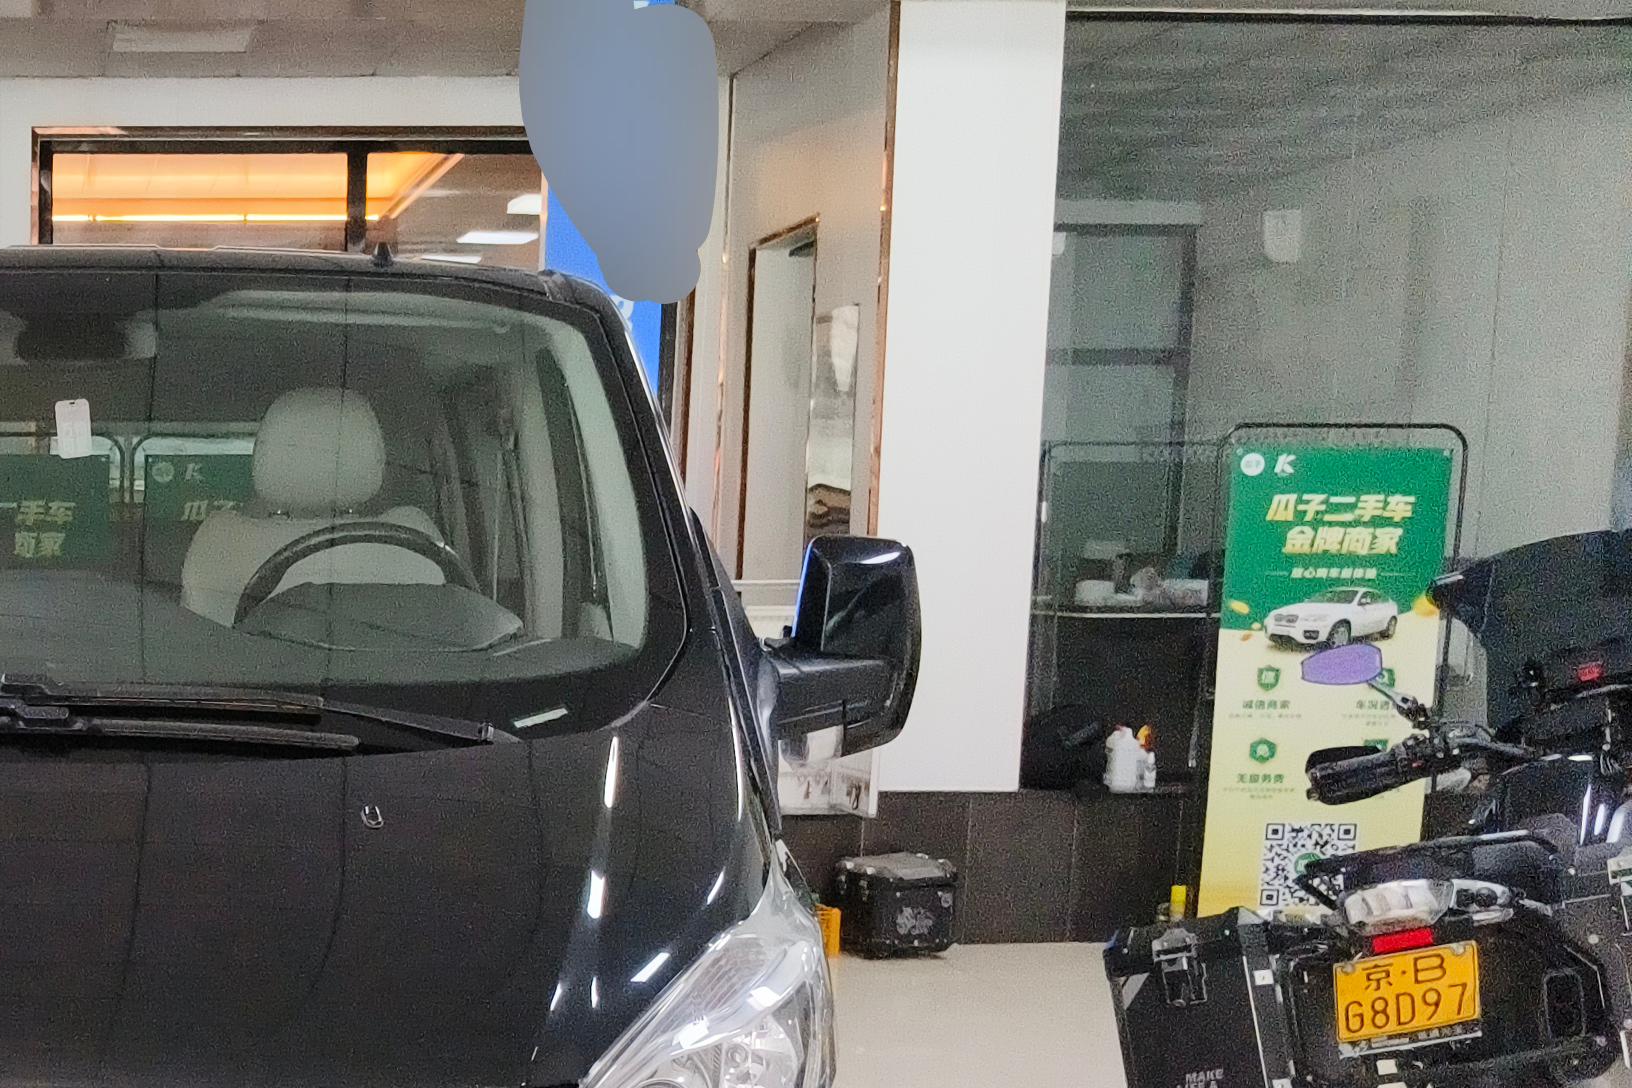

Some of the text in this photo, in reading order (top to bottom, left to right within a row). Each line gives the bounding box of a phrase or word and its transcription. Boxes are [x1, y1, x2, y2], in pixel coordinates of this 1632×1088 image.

[1265, 493, 1416, 522] 瓜子二手车
[1282, 526, 1404, 556] 金牌商家
[1344, 982, 1468, 1034] G8D97
[1185, 1068, 1224, 1083] MAKE
